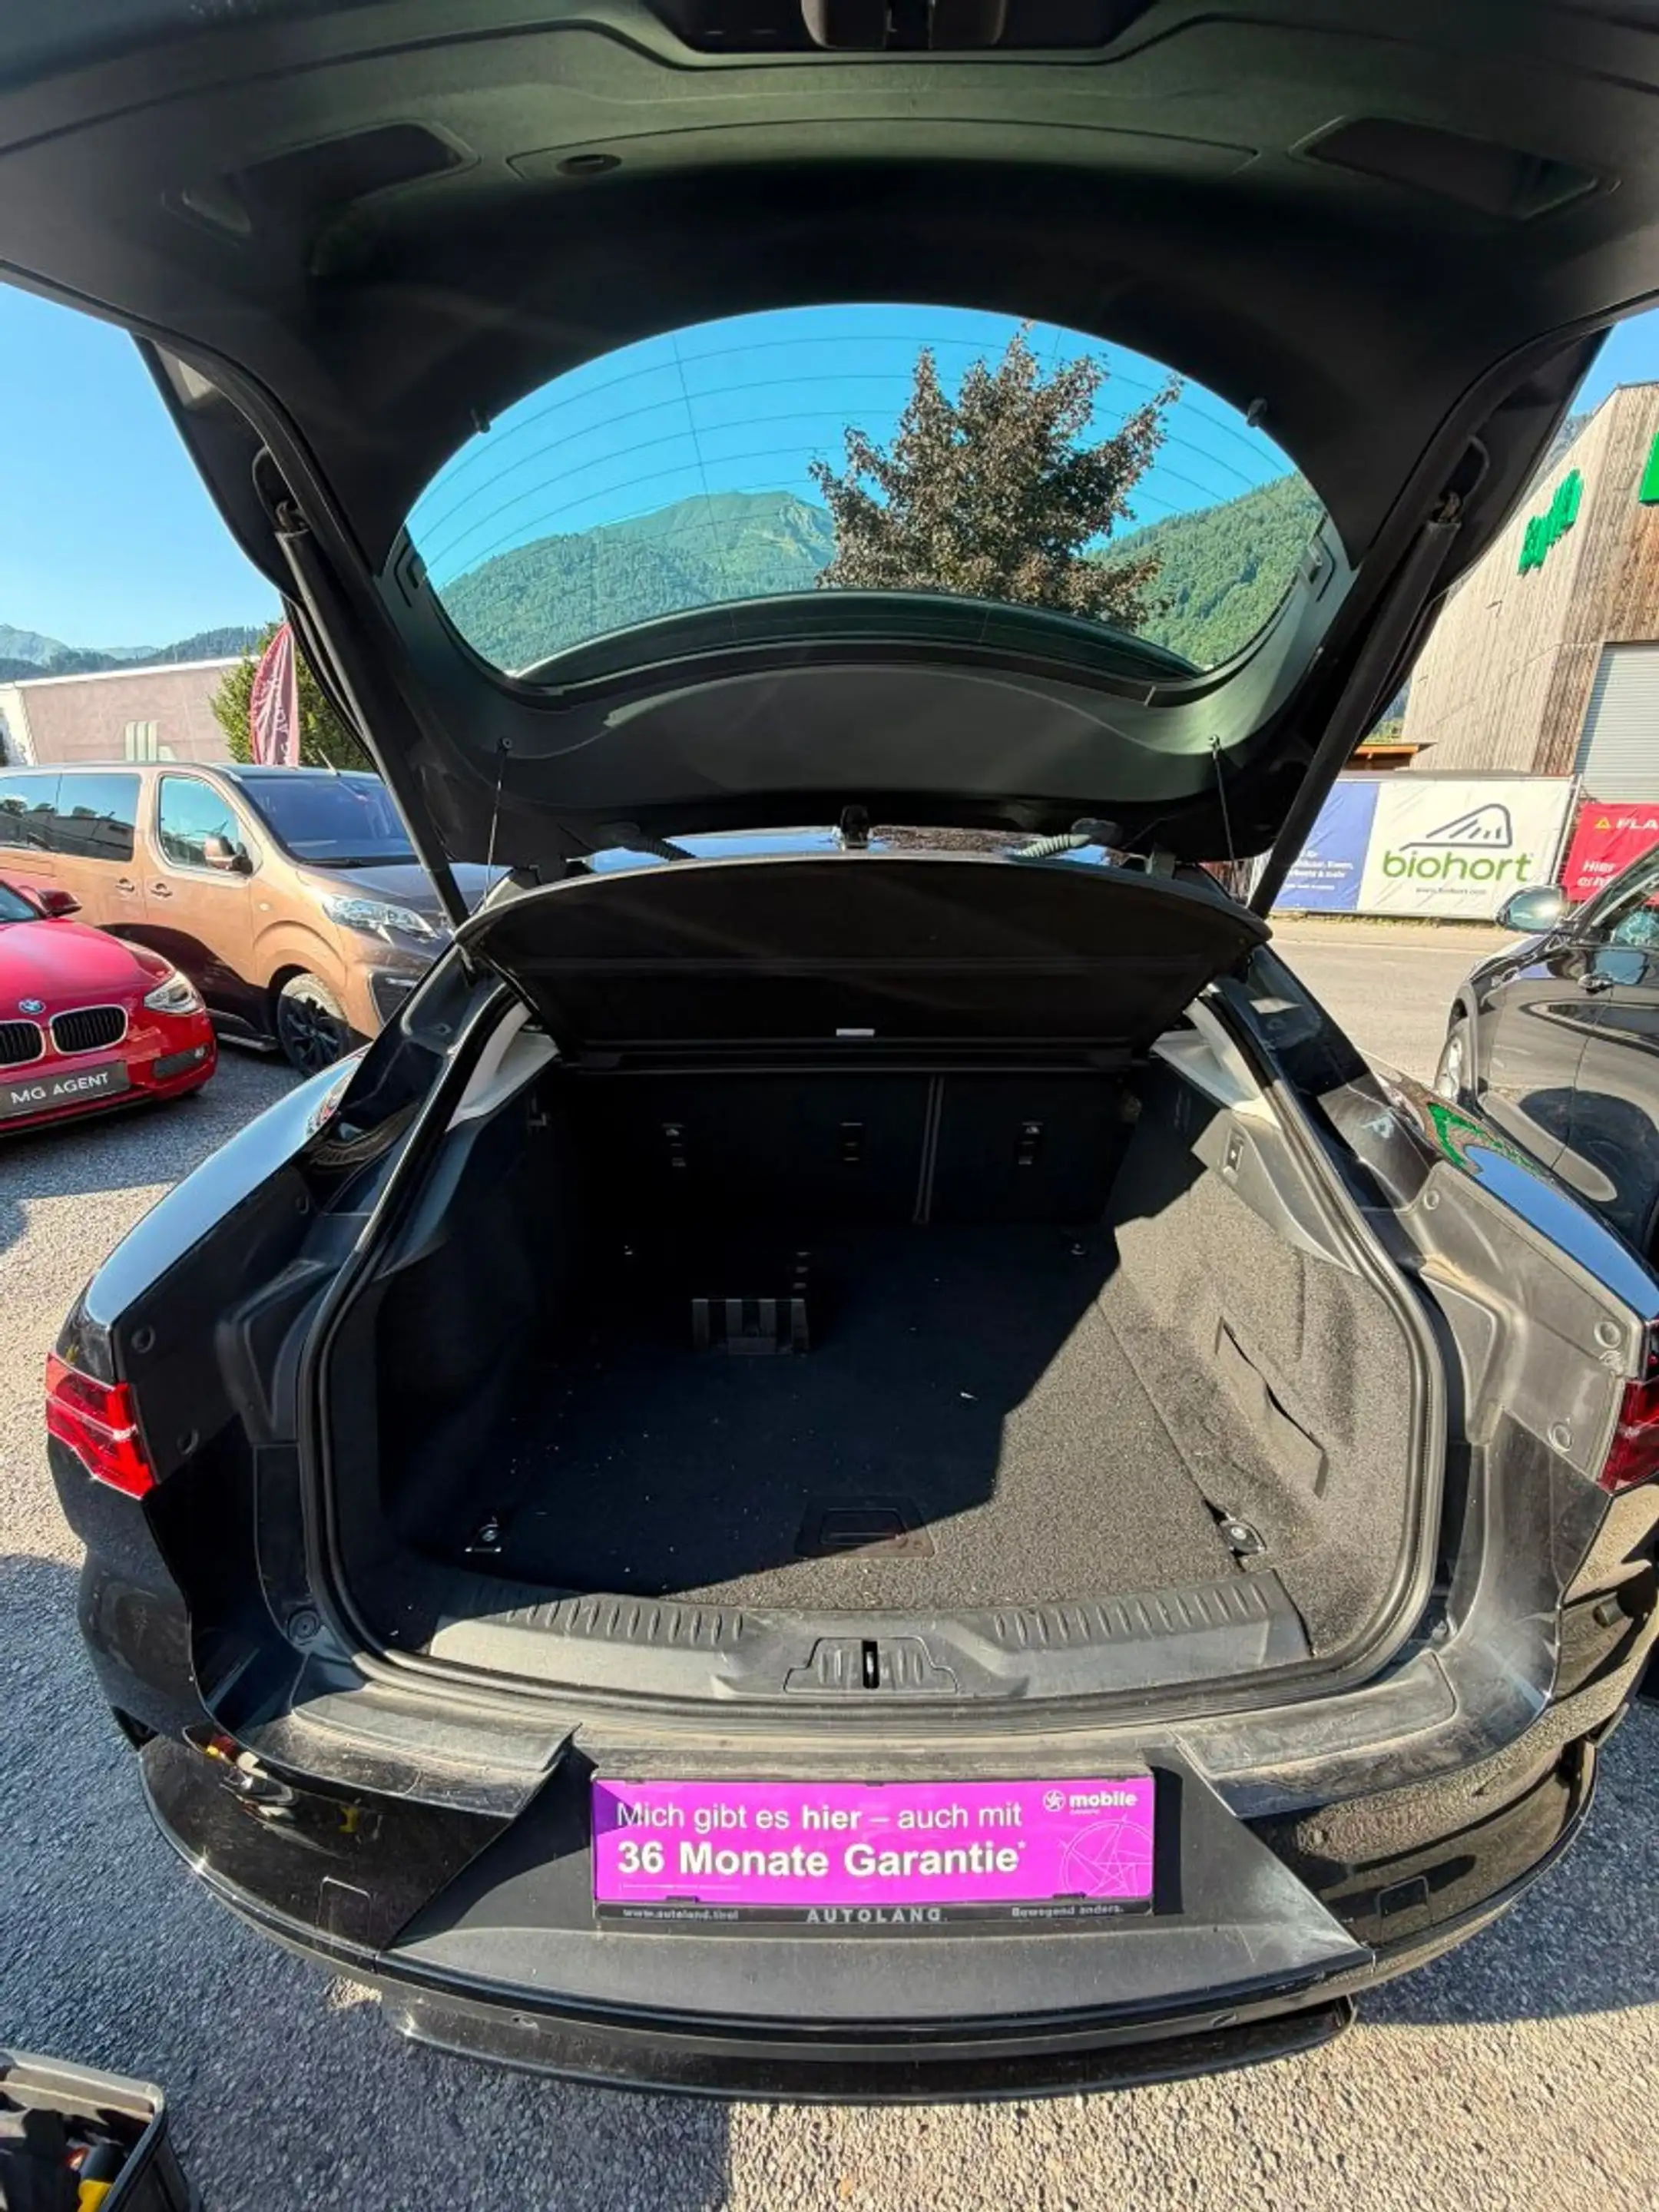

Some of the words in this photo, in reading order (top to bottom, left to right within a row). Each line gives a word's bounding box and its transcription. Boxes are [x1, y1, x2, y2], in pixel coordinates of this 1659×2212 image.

[1382, 850, 1532, 882] biohort
[10, 1087, 46, 1104] MG
[52, 1071, 108, 1095] AGENT
[1069, 1790, 1137, 1807] mobile
[617, 1802, 684, 1828] Mich
[694, 1803, 748, 1834] gibt
[755, 1812, 790, 1829] es
[802, 1804, 862, 1830] hier
[897, 1803, 969, 1829] auch
[979, 1801, 1022, 1826] mit
[618, 1841, 664, 1874] 36
[679, 1841, 830, 1876] Monate
